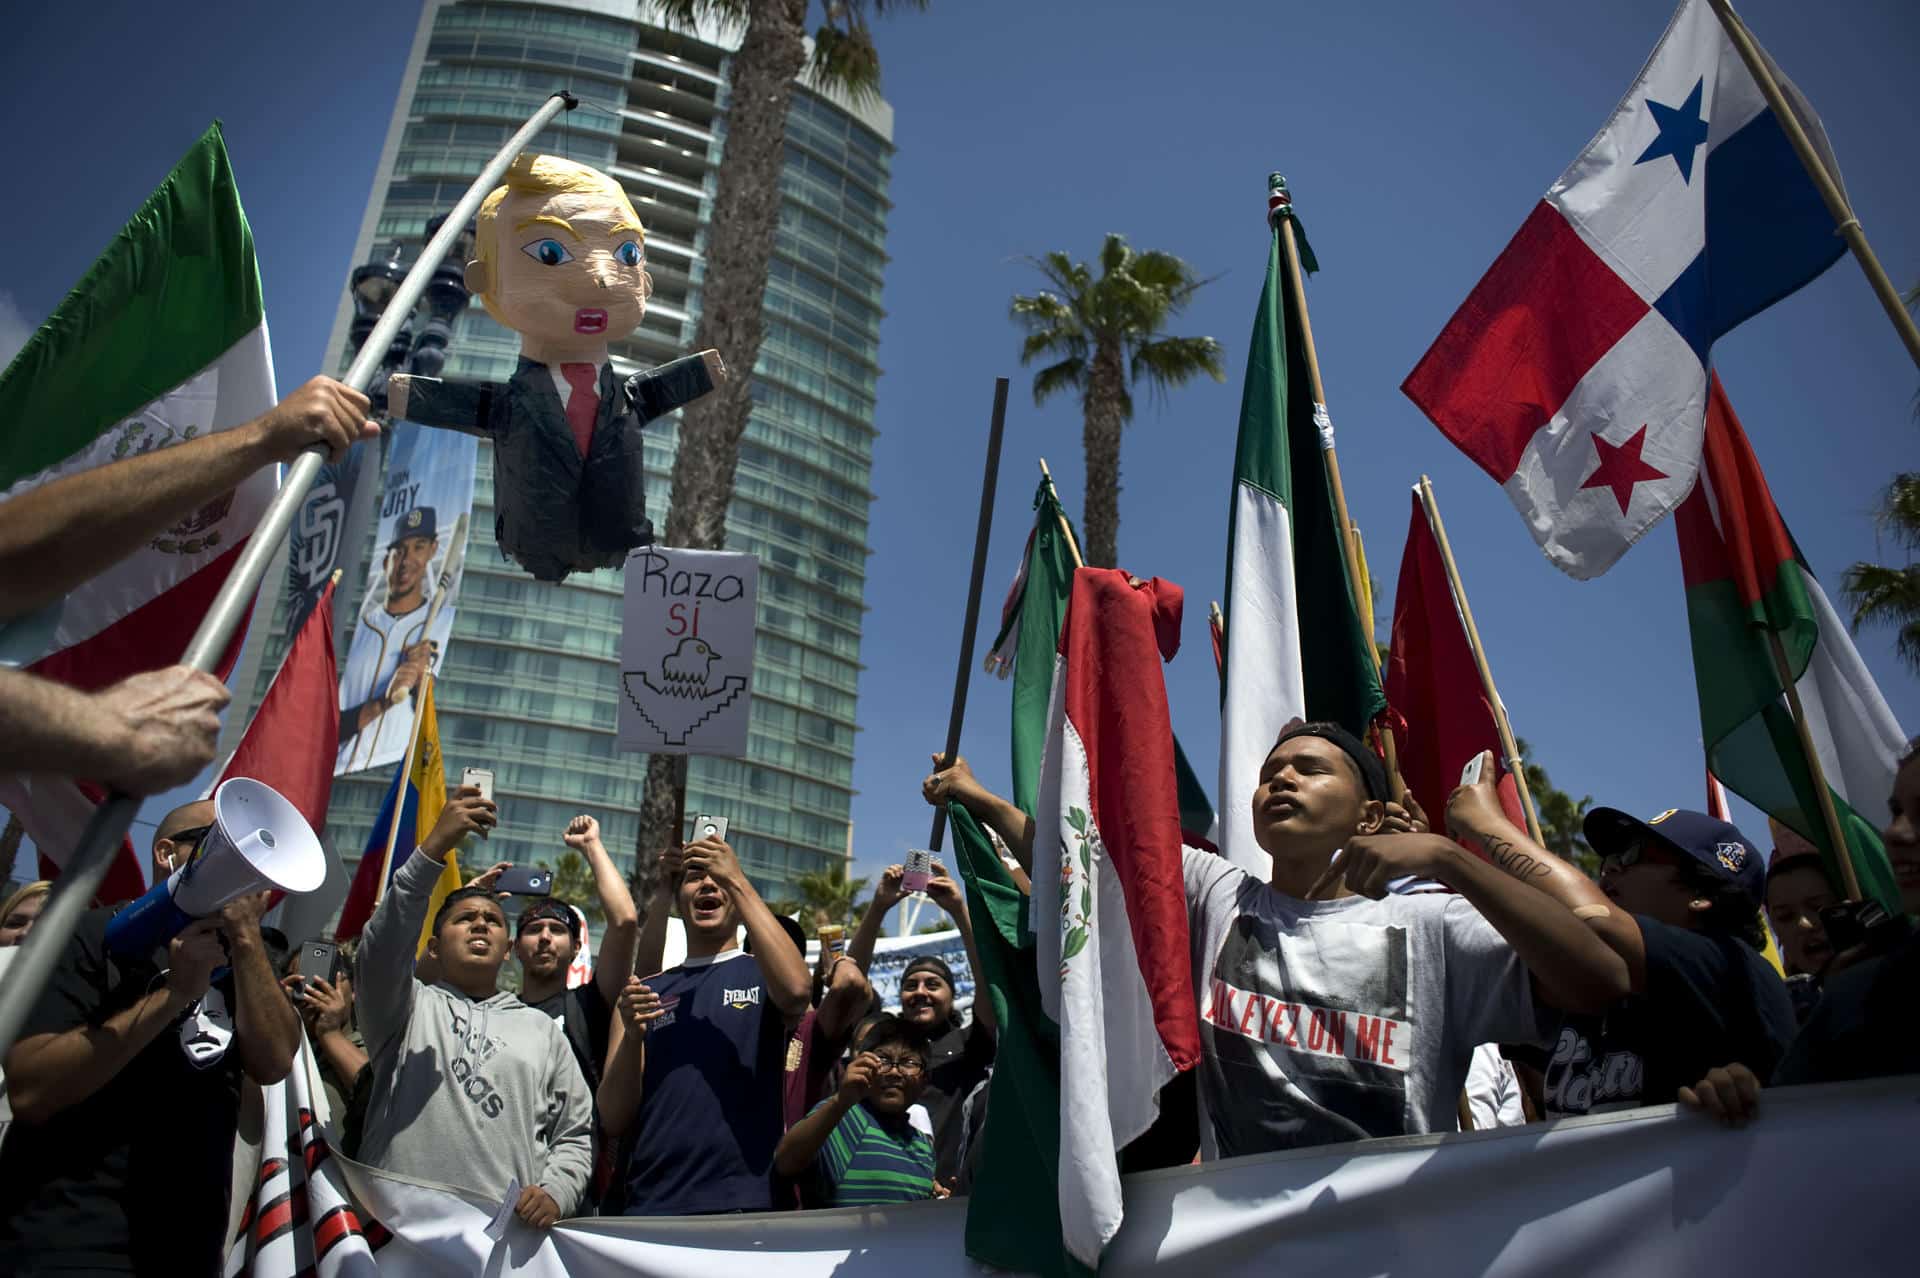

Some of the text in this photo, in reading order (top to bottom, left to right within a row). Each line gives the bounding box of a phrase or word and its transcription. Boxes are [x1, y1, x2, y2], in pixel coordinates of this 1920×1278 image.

[383, 482, 420, 518] JAY
[631, 551, 744, 602] Raza
[723, 986, 760, 1006] EVERLAST
[1206, 982, 1398, 1064] ALL EYEZ ON ME
